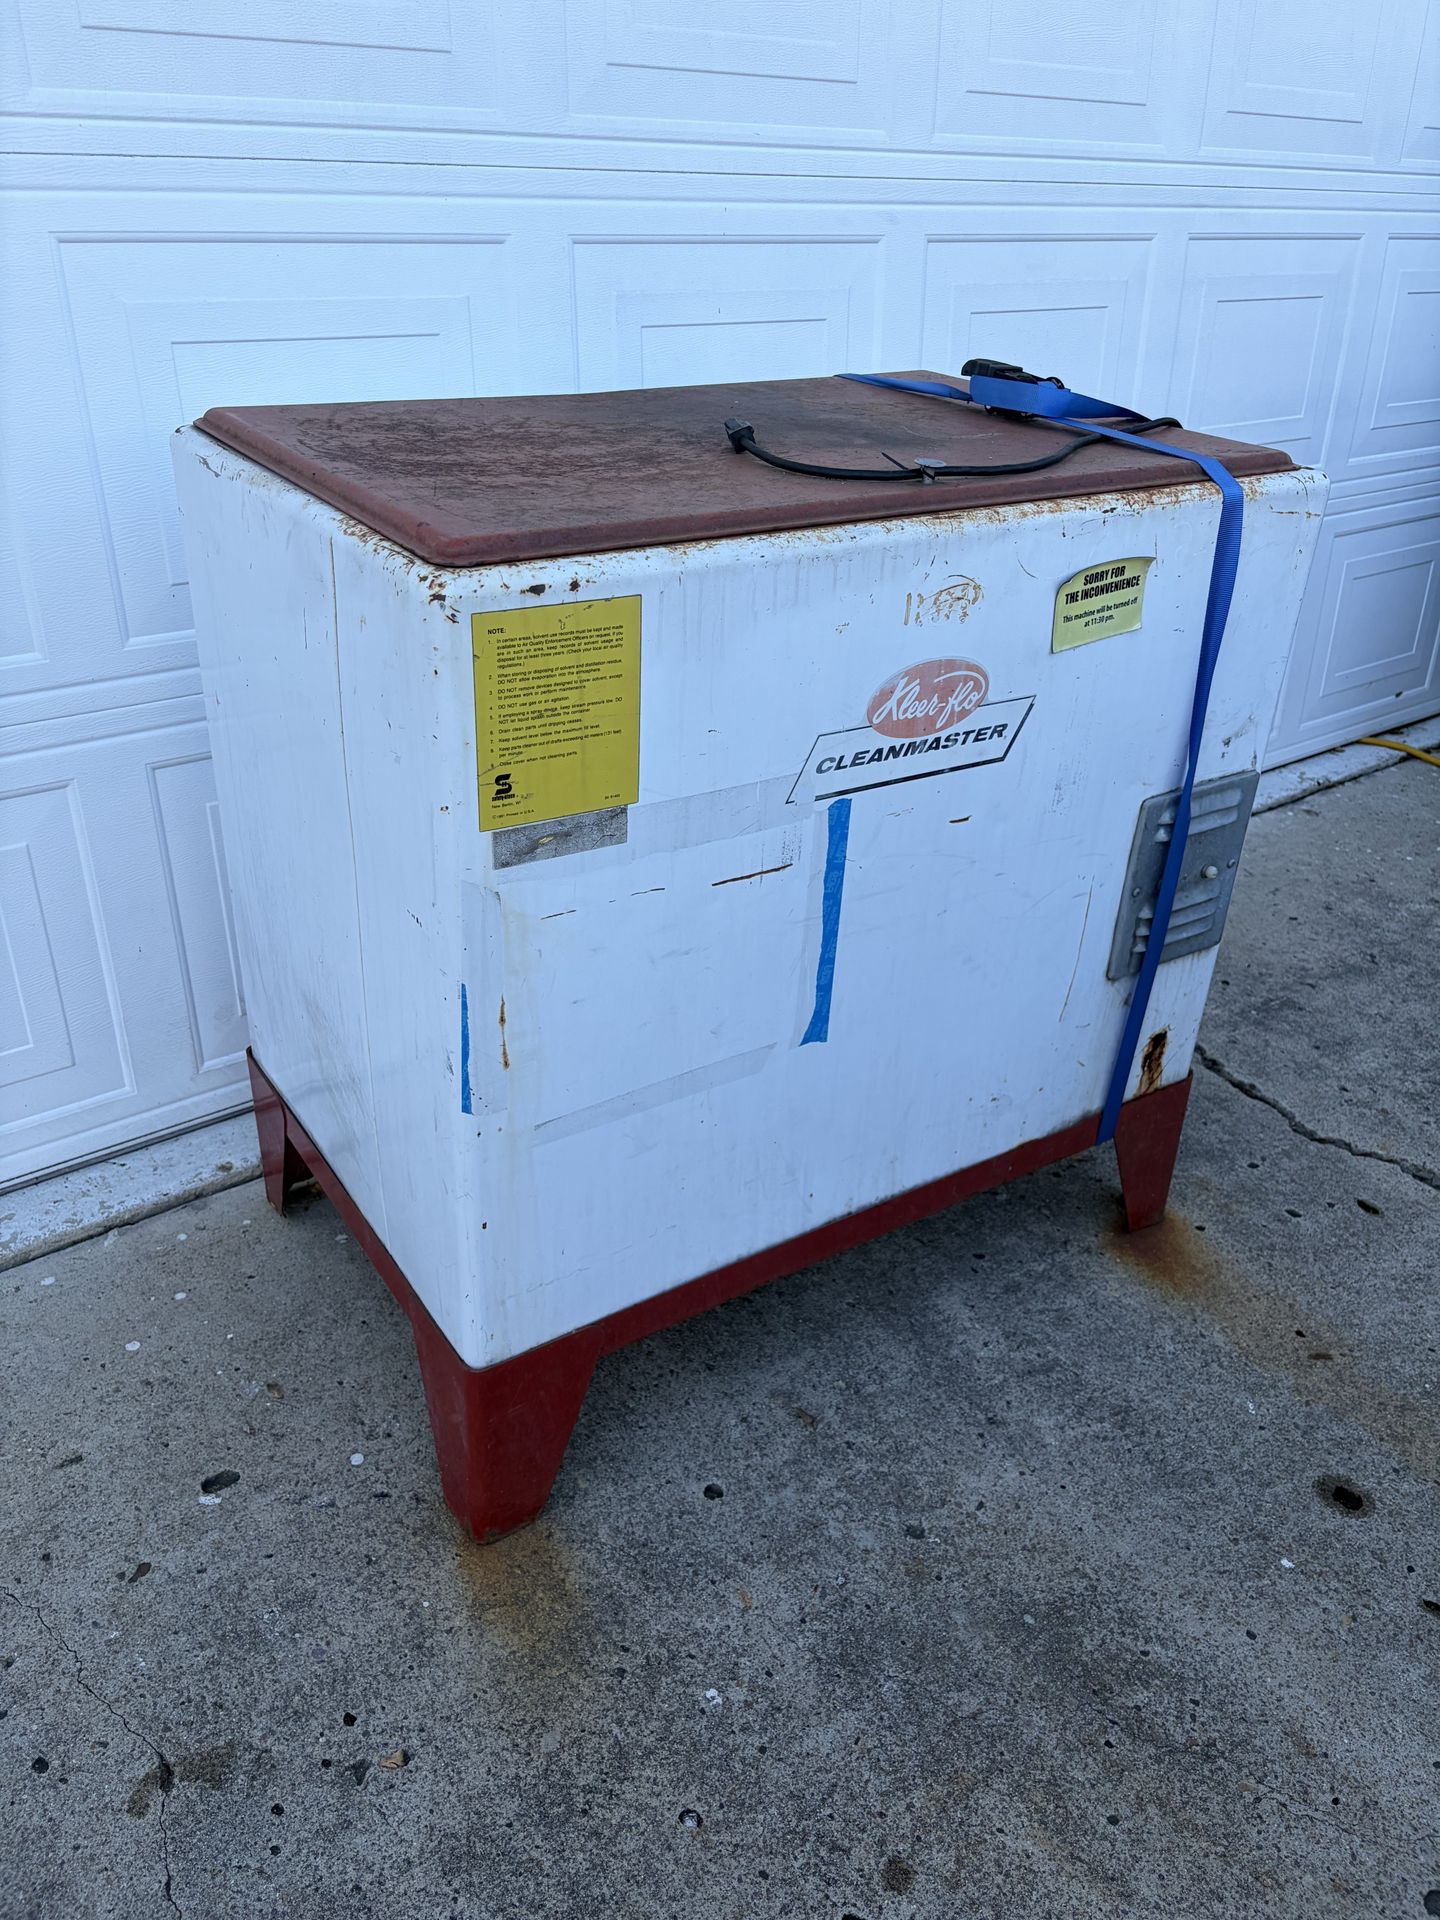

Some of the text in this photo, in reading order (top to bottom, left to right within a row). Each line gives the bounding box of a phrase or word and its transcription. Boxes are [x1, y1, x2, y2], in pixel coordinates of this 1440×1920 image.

[1084, 566, 1126, 585] SORRY FOR
[1065, 575, 1141, 605] THE INCONVENIENCE
[1063, 596, 1138, 624] This machine will be turned off
[1084, 614, 1115, 627] at 11:30 pm.
[533, 666, 553, 674] disposing
[532, 672, 557, 681] evaporation
[554, 679, 573, 688] designed
[503, 710, 525, 719] employing
[548, 719, 565, 728] dripping
[563, 734, 583, 743] exceeding
[815, 722, 1007, 775] CLEANMASTER
[548, 752, 565, 760] cleaning
